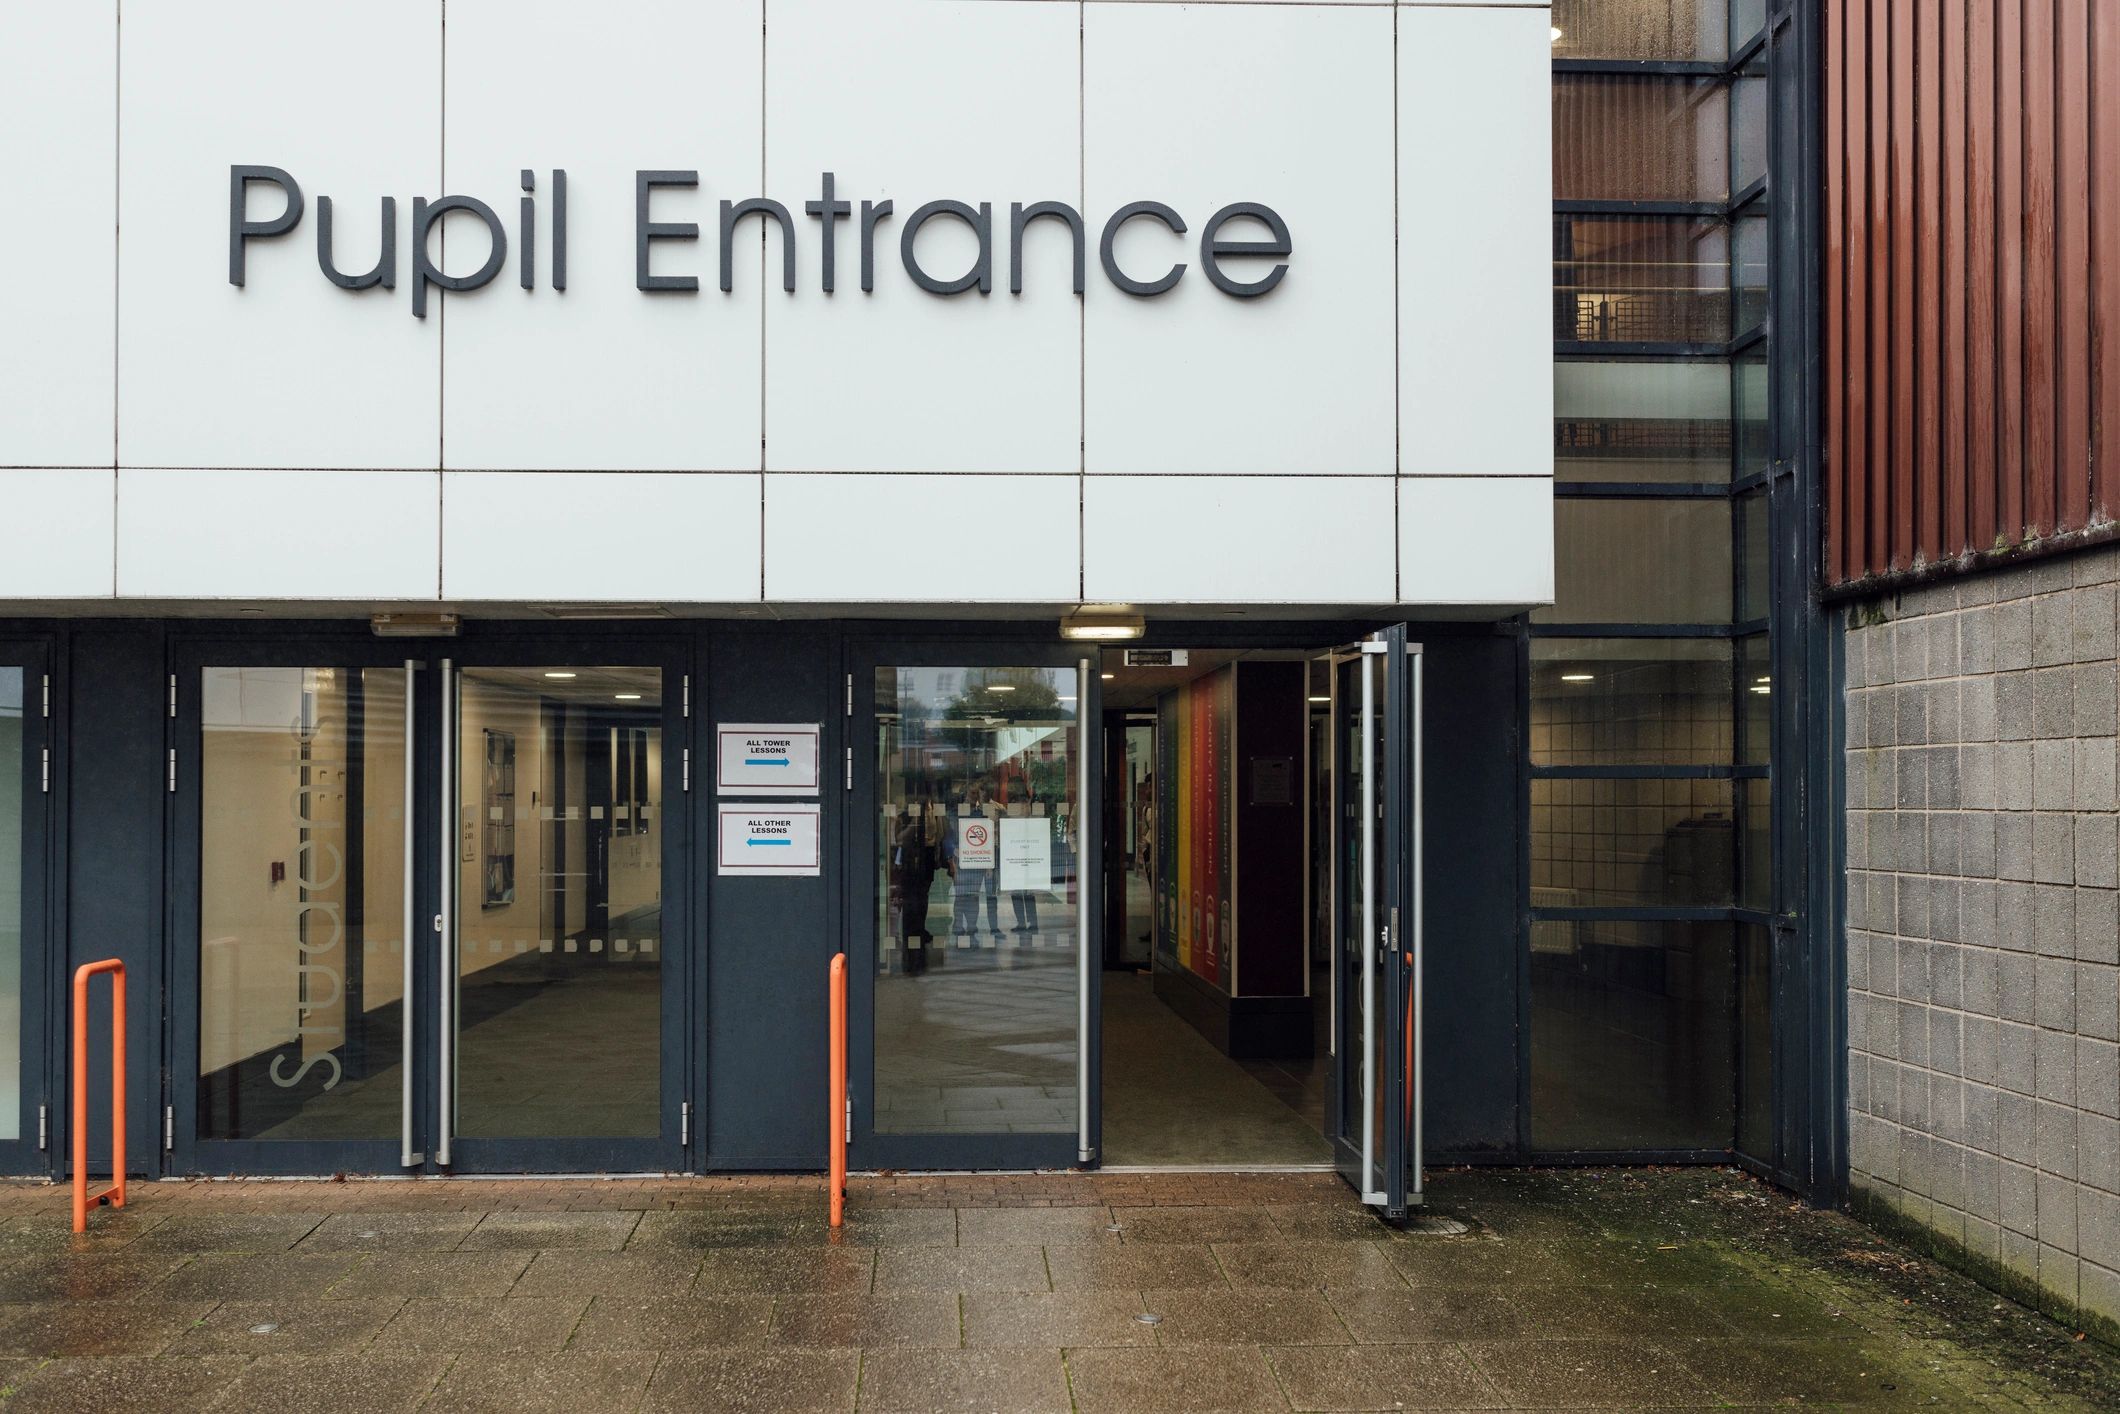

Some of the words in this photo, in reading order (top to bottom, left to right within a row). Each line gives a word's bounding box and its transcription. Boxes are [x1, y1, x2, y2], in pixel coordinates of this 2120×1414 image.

[229, 164, 567, 318] Pupil
[636, 170, 1292, 298] Entrance
[269, 715, 342, 1092] Students
